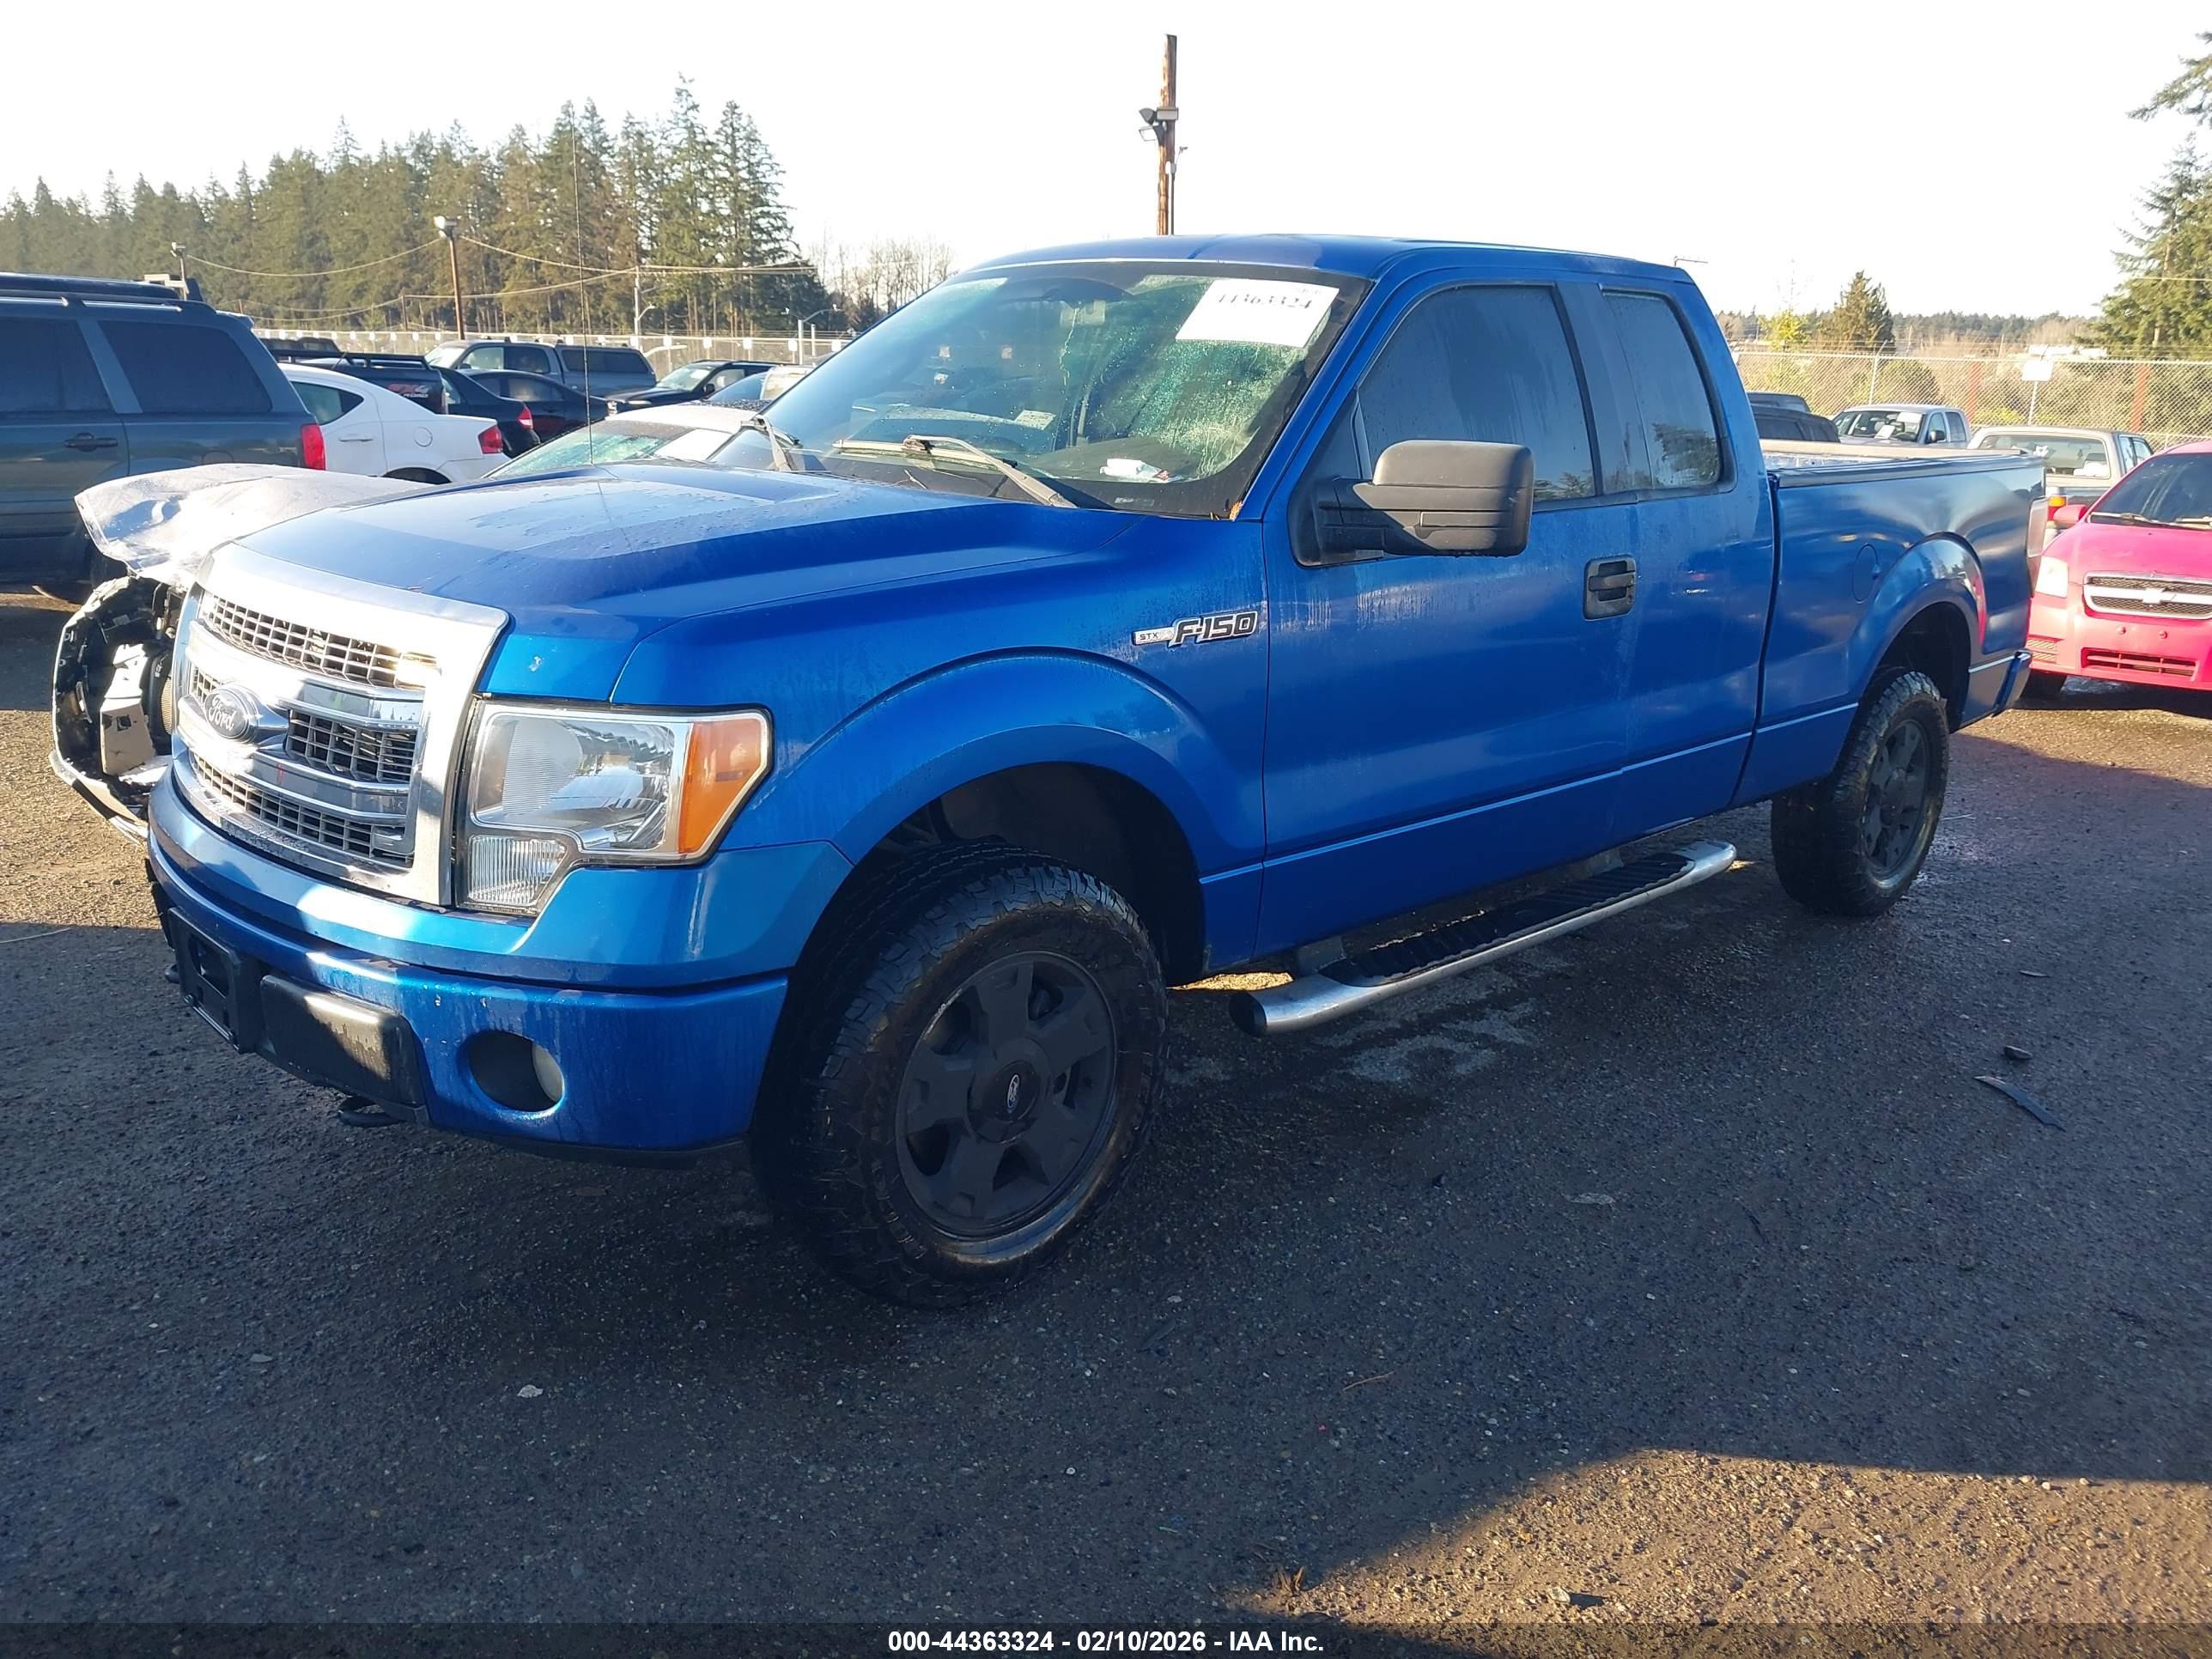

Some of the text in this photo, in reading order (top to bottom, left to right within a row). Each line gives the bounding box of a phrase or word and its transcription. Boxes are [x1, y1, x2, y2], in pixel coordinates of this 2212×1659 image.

[1139, 611, 1258, 645] STX F-150
[207, 694, 237, 732] Ford
